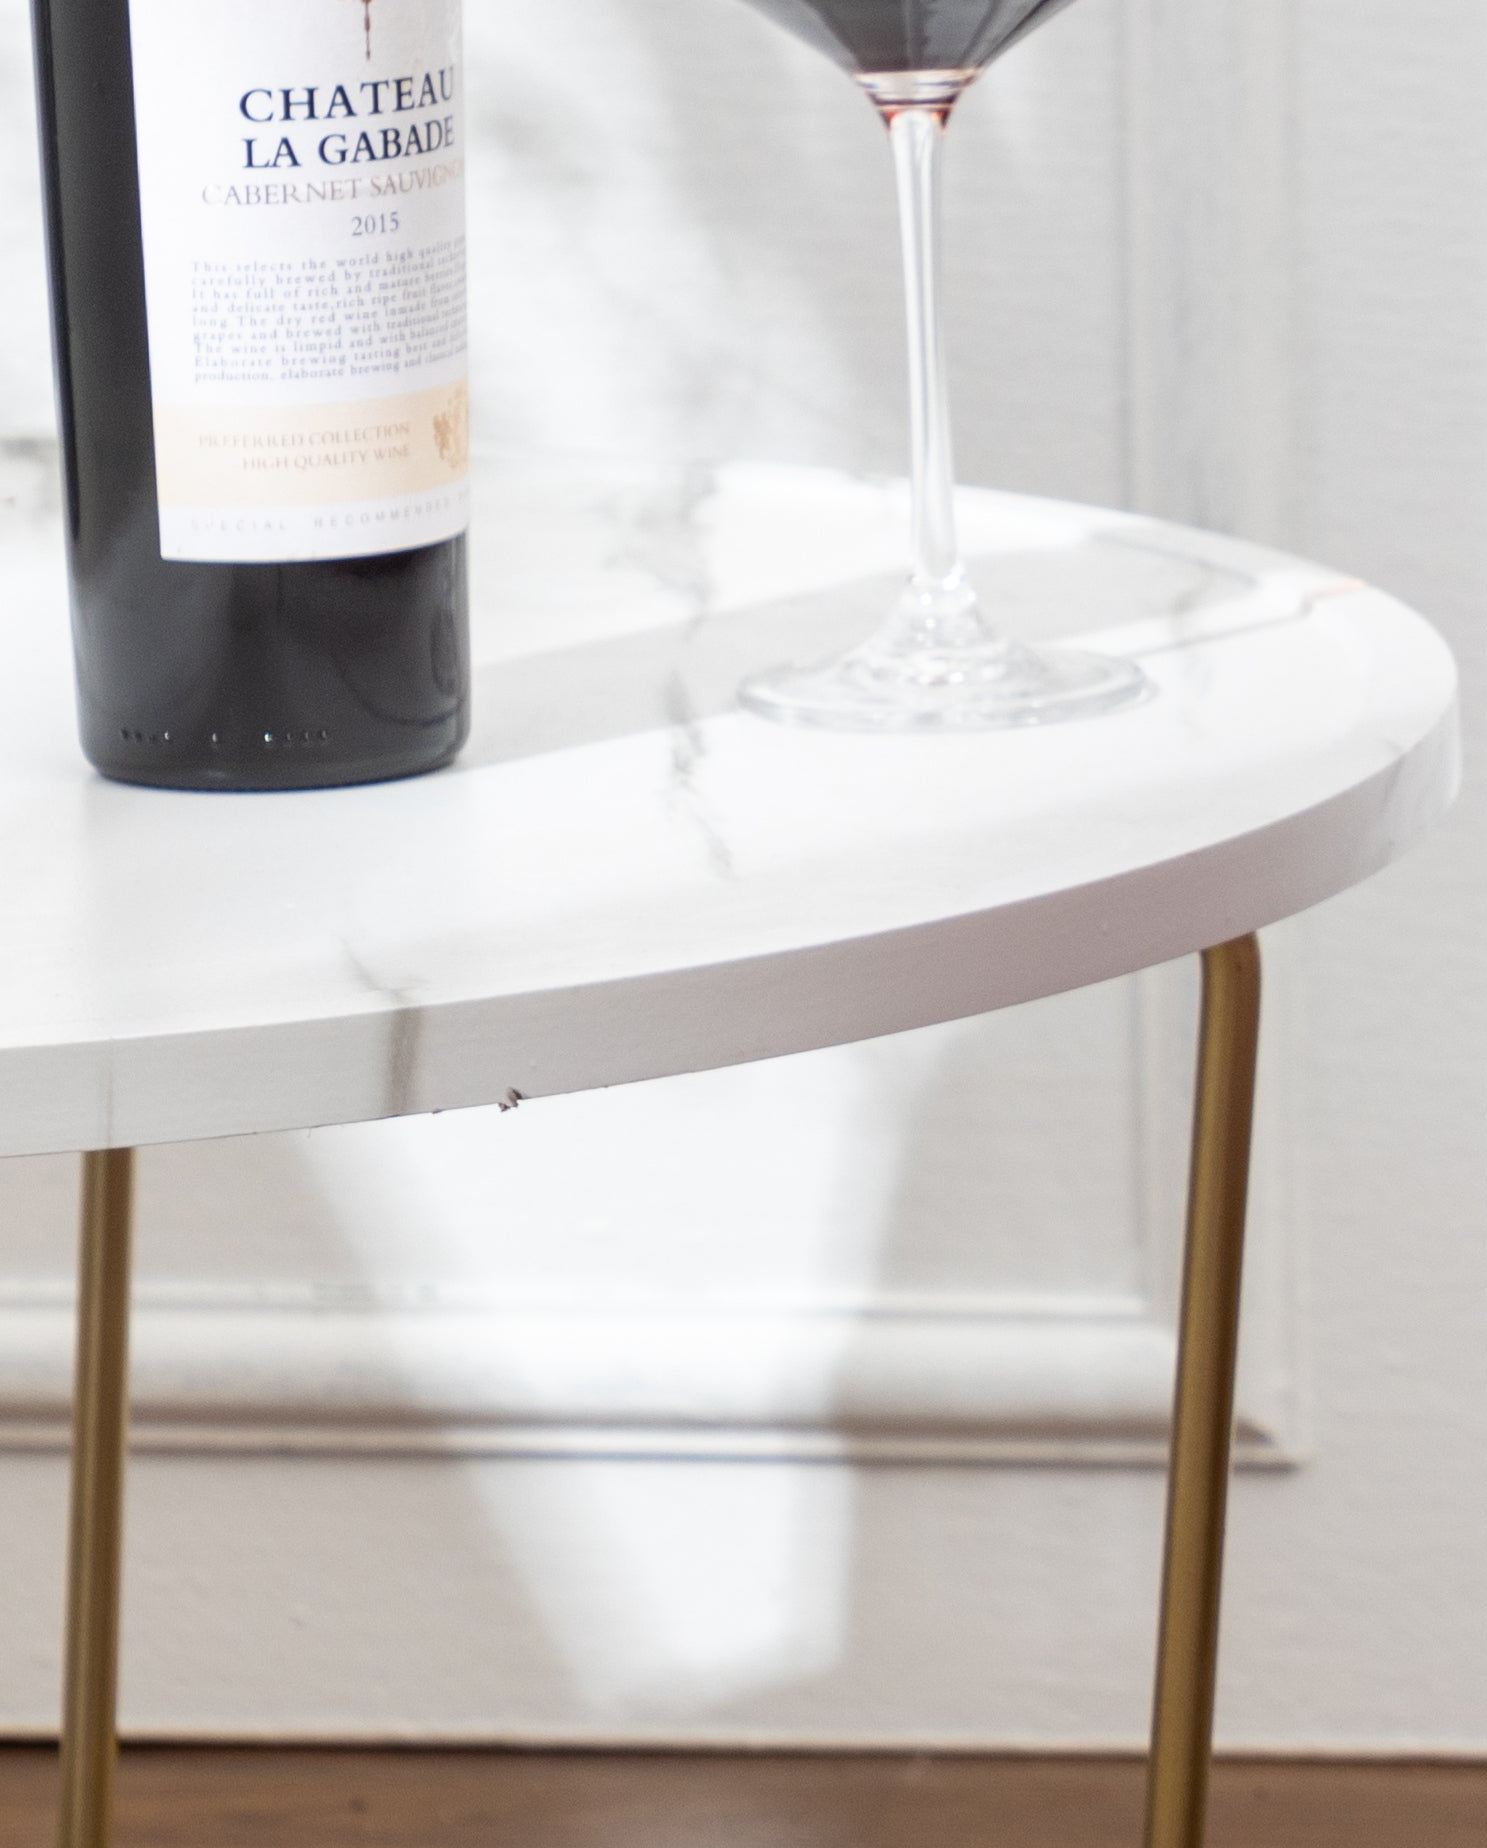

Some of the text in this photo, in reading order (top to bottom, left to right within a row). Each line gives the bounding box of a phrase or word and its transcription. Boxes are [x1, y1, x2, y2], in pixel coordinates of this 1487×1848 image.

[239, 65, 455, 123] CHATEAU
[243, 114, 455, 169] LA GABADE
[201, 178, 363, 206] CABERNET
[351, 210, 401, 237] 2015
[301, 258, 326, 271] the
[336, 252, 378, 266] world
[386, 248, 413, 263] high
[276, 270, 336, 285] brewed
[345, 269, 361, 281] by
[213, 289, 237, 300] has
[246, 288, 275, 299] full
[283, 286, 301, 298] of
[308, 284, 338, 298] rich
[347, 281, 371, 295] and
[193, 303, 218, 313] and
[236, 314, 267, 327] The
[277, 313, 301, 327] dry
[312, 310, 336, 324] red
[344, 309, 379, 322] wine
[231, 344, 267, 354] wine
[349, 334, 372, 348] and
[380, 330, 405, 343] with
[251, 328, 277, 340] and
[286, 325, 342, 340] brewed
[350, 321, 381, 333] with
[281, 353, 346, 367] brewing
[350, 361, 400, 376] brewing
[196, 420, 411, 449] PREFERRED COLLECTION
[242, 442, 410, 472] HIGH QUALITY WINE
